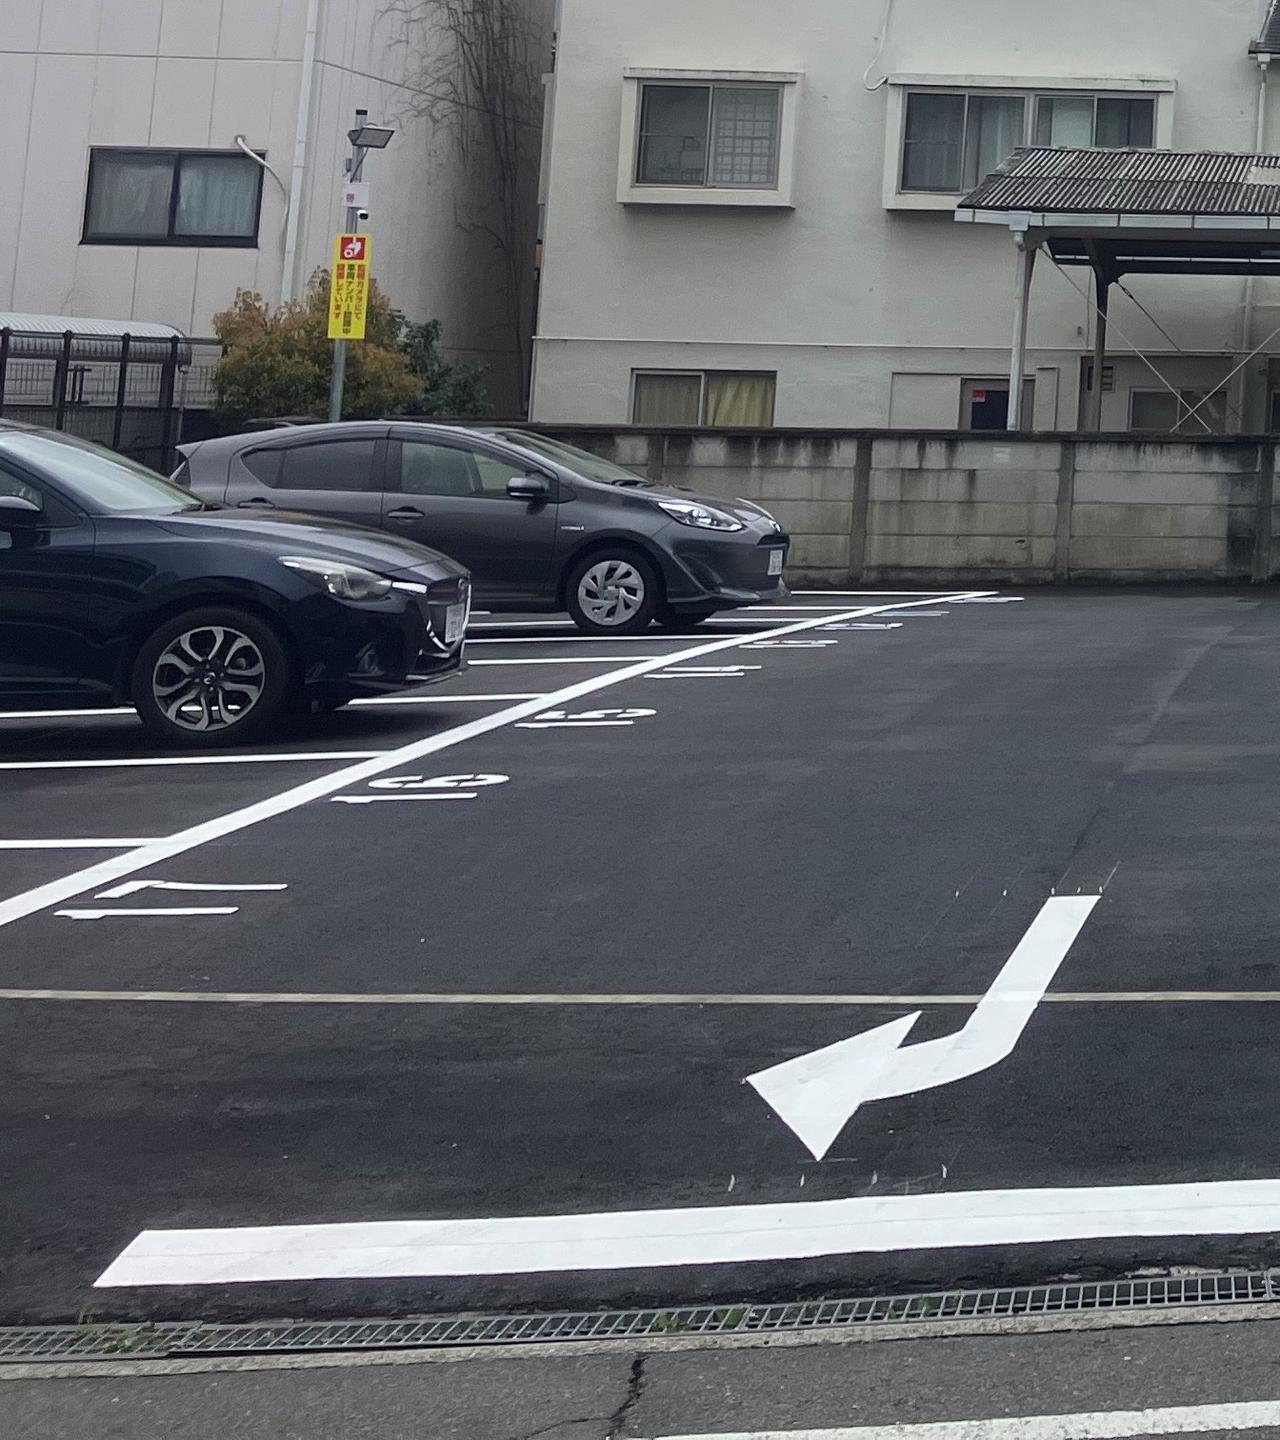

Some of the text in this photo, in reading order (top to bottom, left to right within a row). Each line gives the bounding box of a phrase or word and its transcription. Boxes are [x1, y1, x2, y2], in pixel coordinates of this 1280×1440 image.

[514, 707, 657, 729] 15
[331, 772, 511, 803] 16
[54, 878, 288, 919] 17
